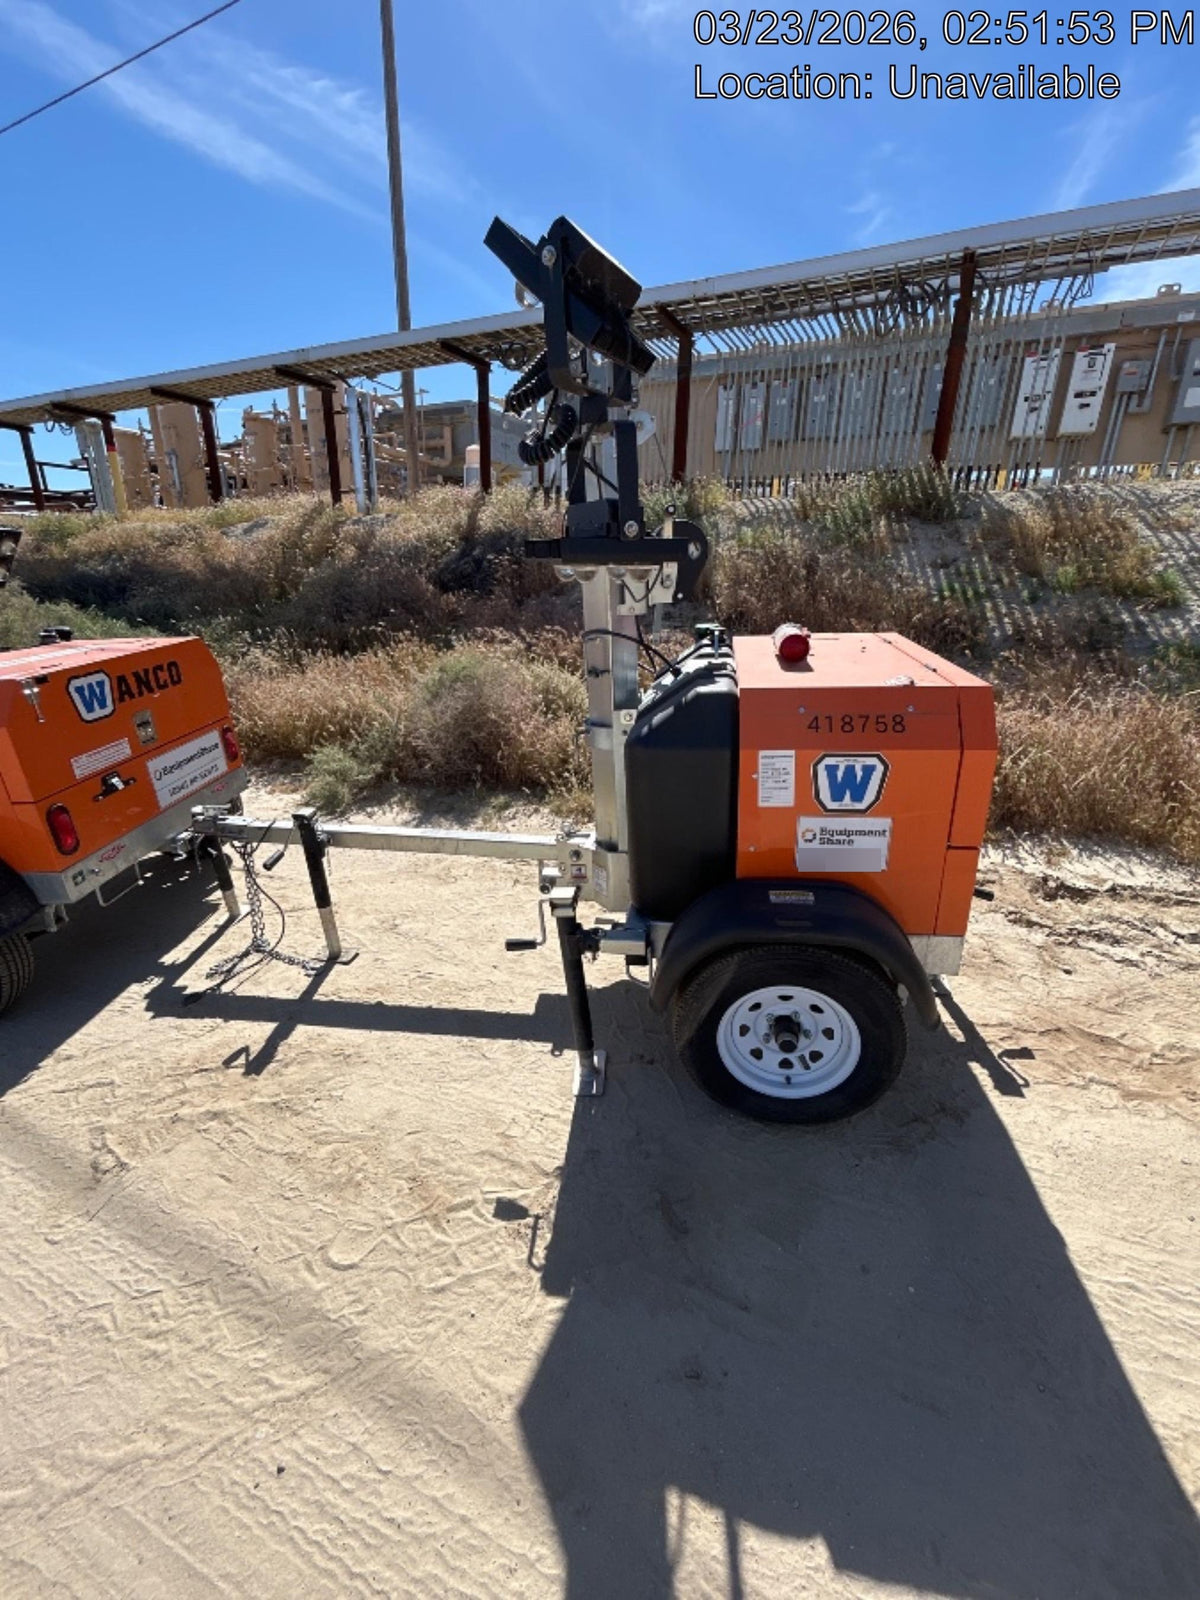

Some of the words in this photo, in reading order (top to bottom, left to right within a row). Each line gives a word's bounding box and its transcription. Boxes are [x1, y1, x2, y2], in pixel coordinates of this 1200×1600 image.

[807, 714, 907, 734] 418758
[824, 763, 877, 803] W
[818, 826, 888, 838] Equipment
[818, 837, 855, 846] Share
